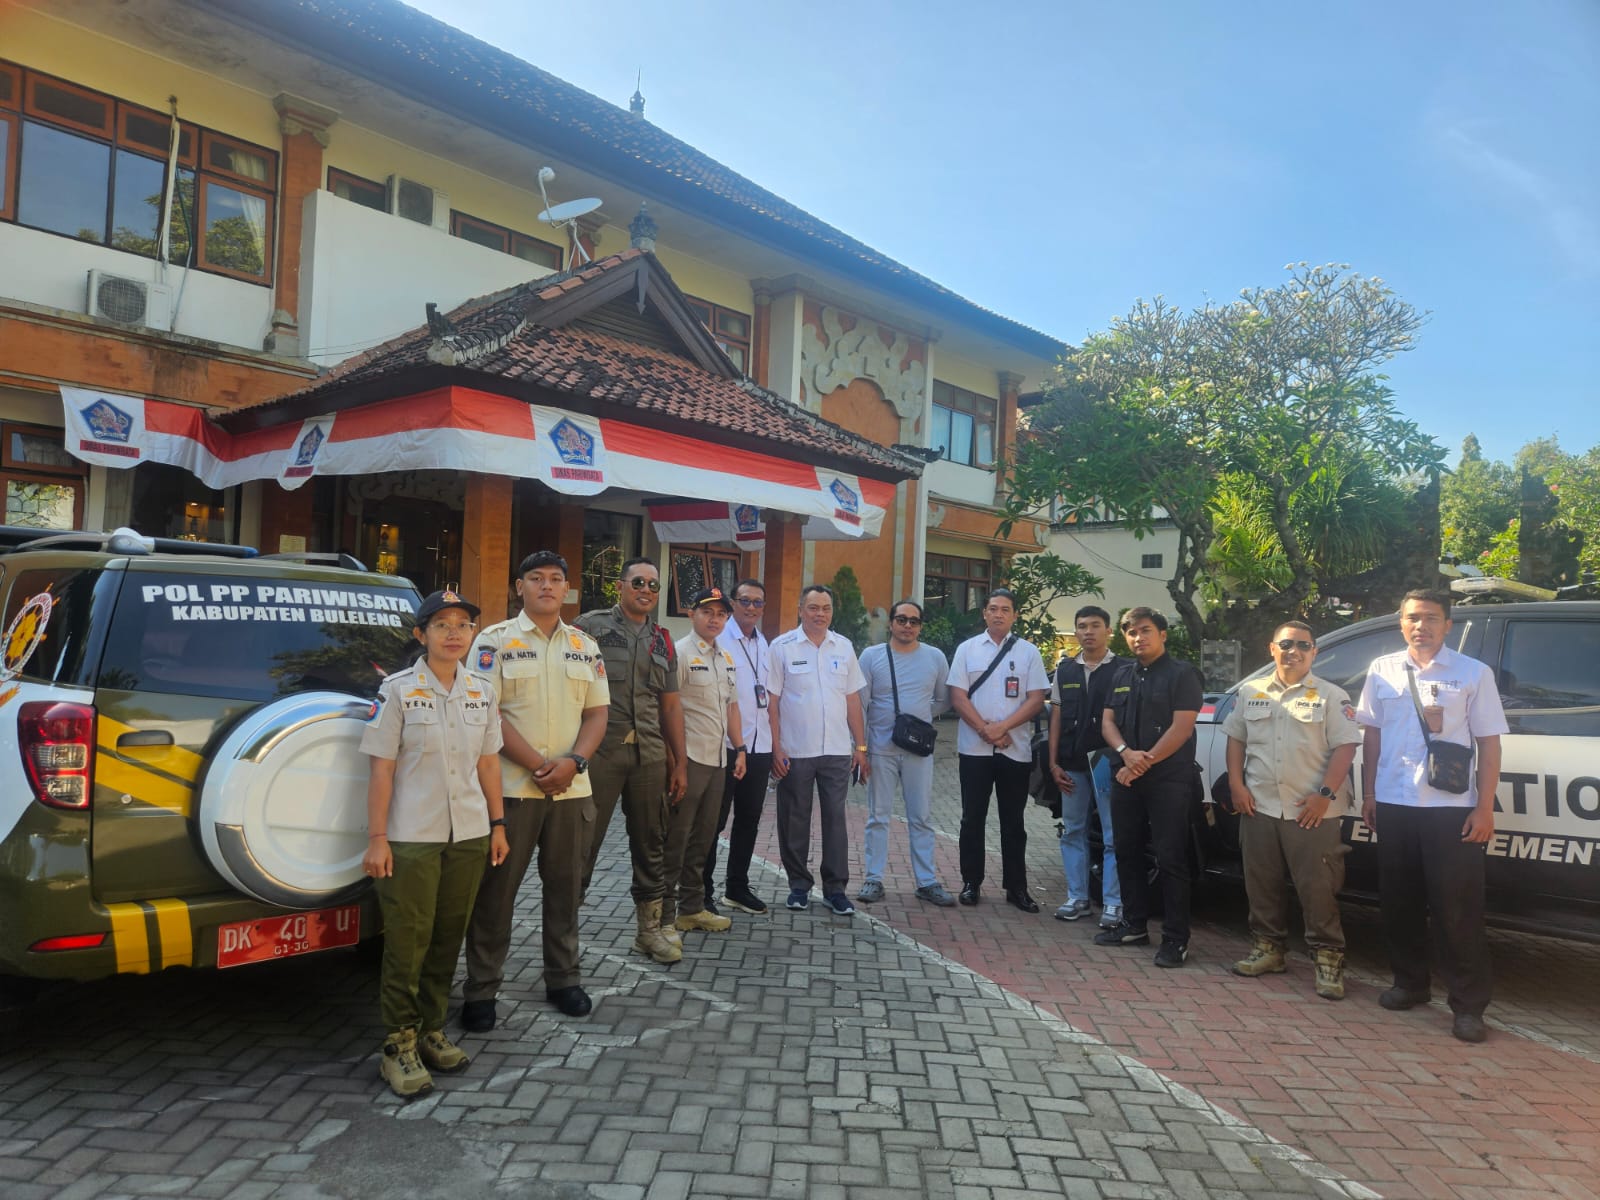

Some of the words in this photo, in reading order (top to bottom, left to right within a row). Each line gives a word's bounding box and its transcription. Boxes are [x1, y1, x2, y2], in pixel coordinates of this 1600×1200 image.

[142, 585, 204, 602] POL
[211, 585, 250, 602] PP
[257, 586, 414, 614] PARIWISATA
[172, 605, 306, 622] KABUPATEN
[310, 610, 402, 628] BULELENG
[565, 652, 583, 661] POL
[405, 700, 434, 710] YENA
[465, 702, 479, 710] POL
[1486, 833, 1600, 865] EMEN
[223, 925, 252, 953] DK
[279, 916, 307, 941] 40
[336, 908, 350, 932] U
